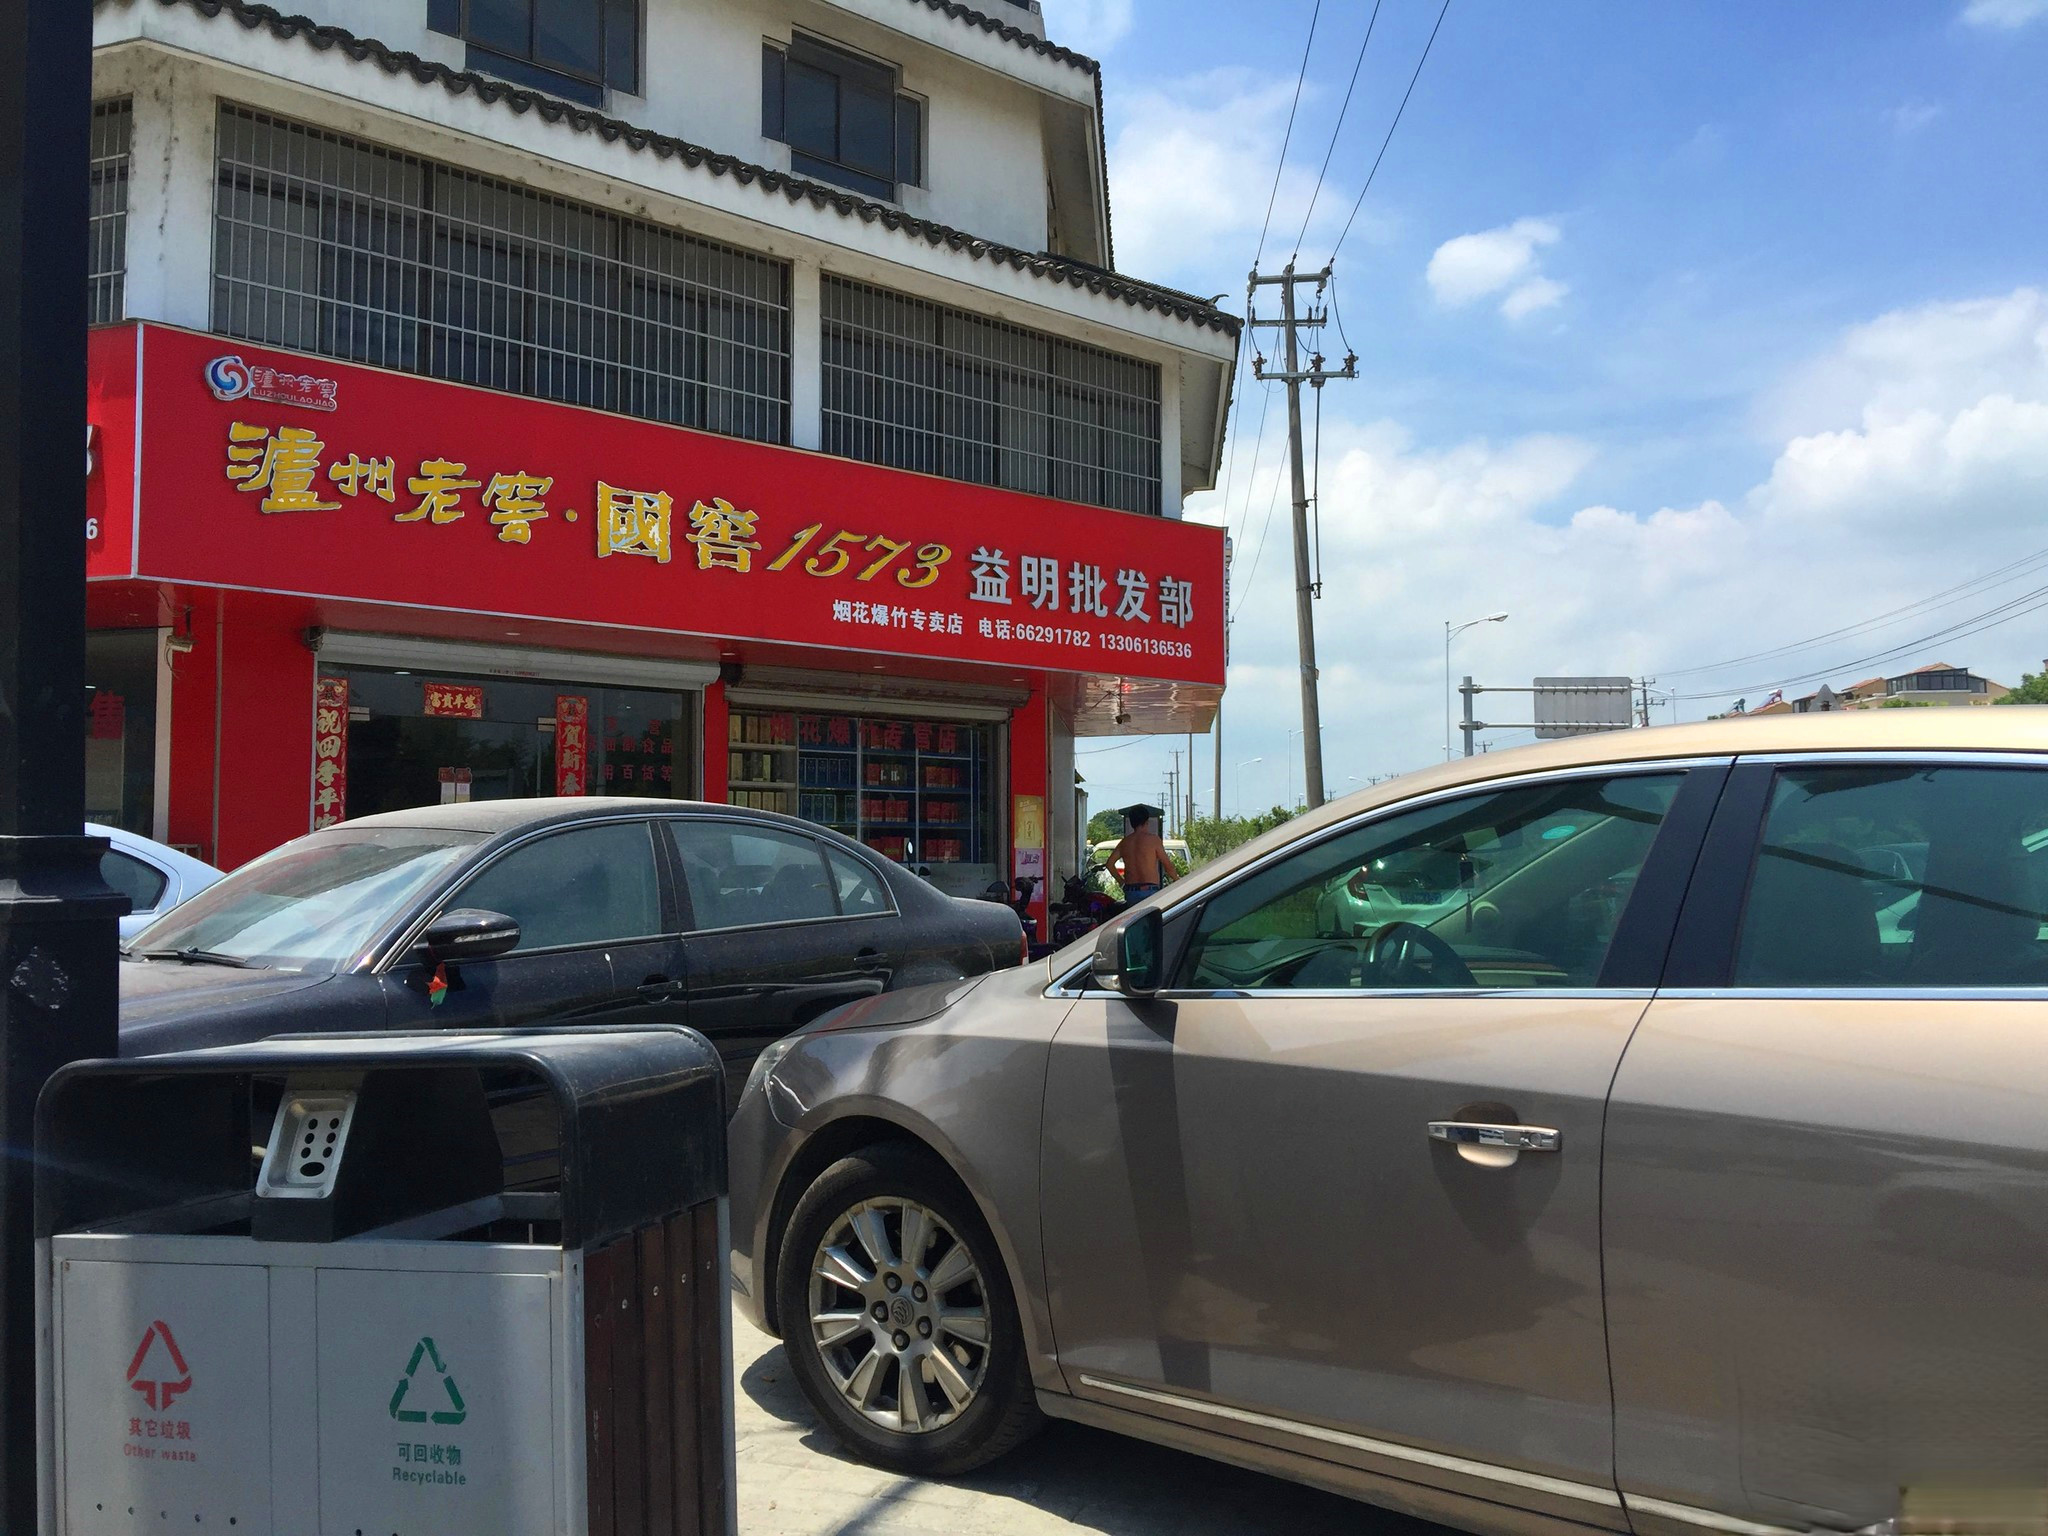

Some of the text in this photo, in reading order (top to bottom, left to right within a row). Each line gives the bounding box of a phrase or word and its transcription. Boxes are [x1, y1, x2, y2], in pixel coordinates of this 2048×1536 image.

[253, 388, 335, 408] LUZHOULAOJIAO
[969, 545, 1195, 630] 益明批发部
[832, 599, 1194, 659] 烟花爆竹专卖店 电话:66291782 13306136536
[128, 1417, 191, 1440] 其它垃圾
[124, 1443, 196, 1462] Other waste
[397, 1442, 461, 1465] 可回收物
[392, 1467, 466, 1486] Recyclable
